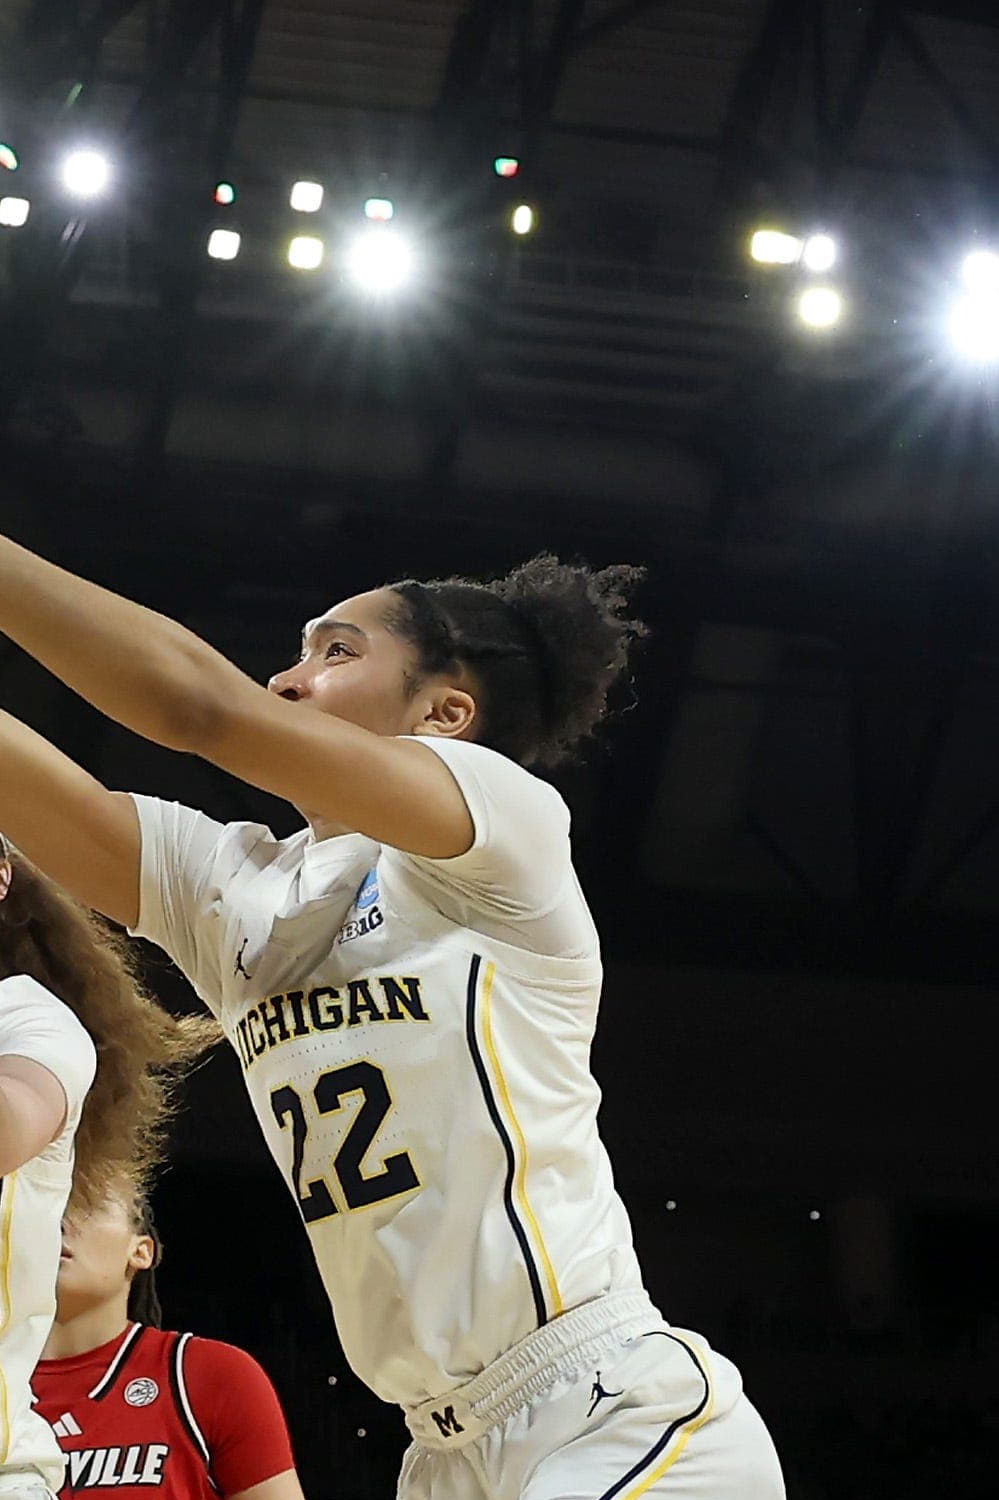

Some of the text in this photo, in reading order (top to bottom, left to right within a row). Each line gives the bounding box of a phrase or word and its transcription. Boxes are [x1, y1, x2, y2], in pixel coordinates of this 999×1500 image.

[234, 975, 430, 1070] ICHIGAN
[269, 1060, 422, 1224] 22
[430, 1404, 465, 1438] M
[65, 1444, 170, 1488] VILLE
